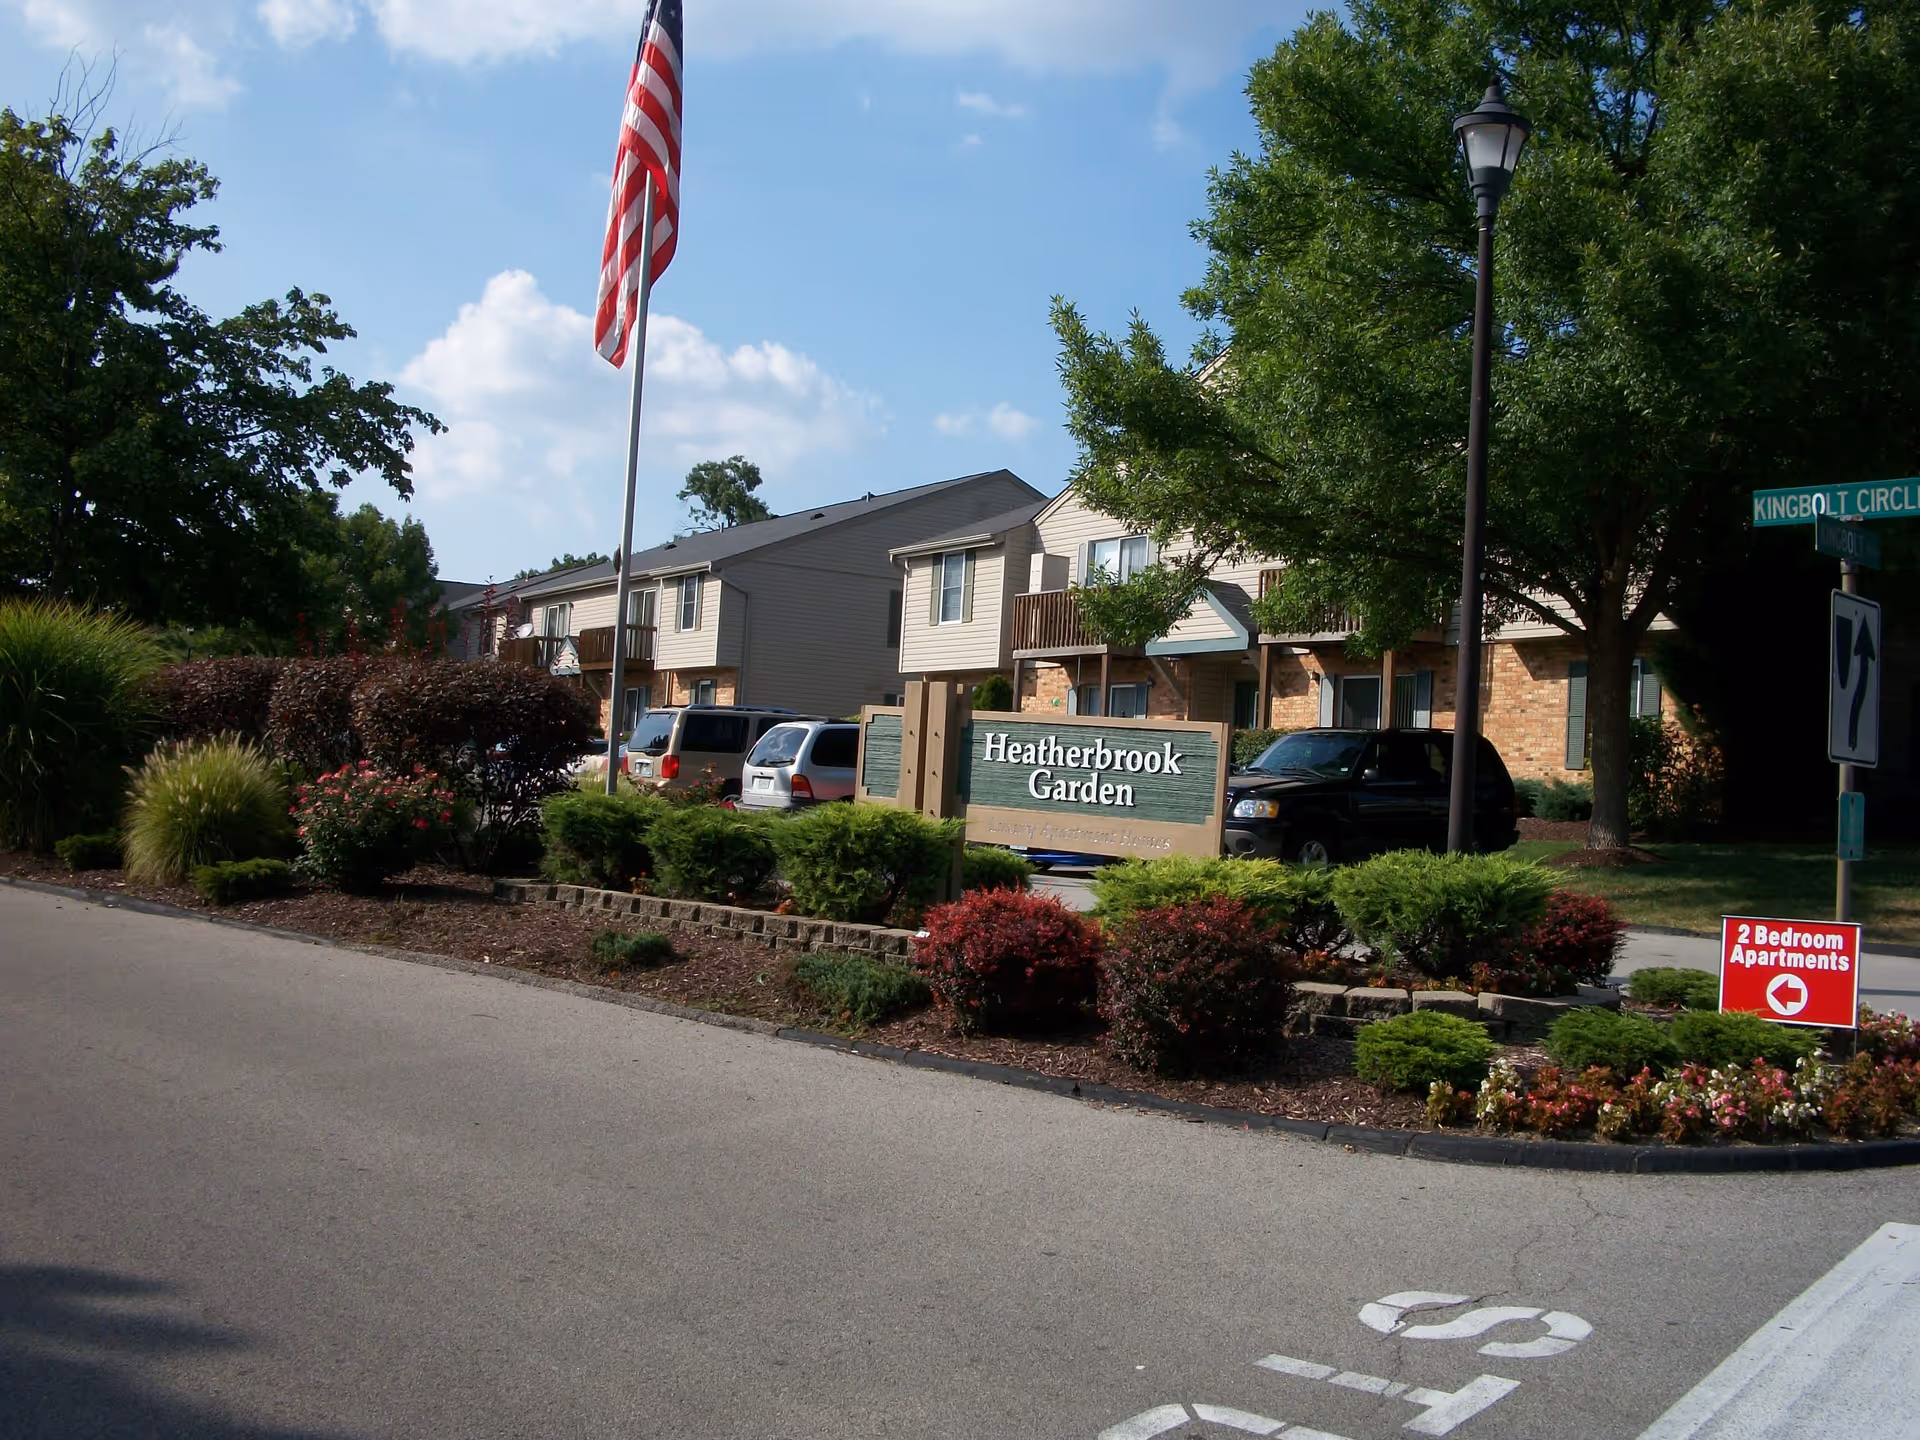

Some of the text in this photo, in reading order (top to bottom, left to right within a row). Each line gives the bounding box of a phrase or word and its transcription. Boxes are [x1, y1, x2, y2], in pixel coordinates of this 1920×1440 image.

[1754, 491, 1849, 521] KINGBOLT
[983, 732, 1183, 775] Heatherbrook
[1028, 768, 1135, 807] Garden
[1737, 923, 1844, 950] 2 Bedroom
[1730, 944, 1850, 972] Apartments
